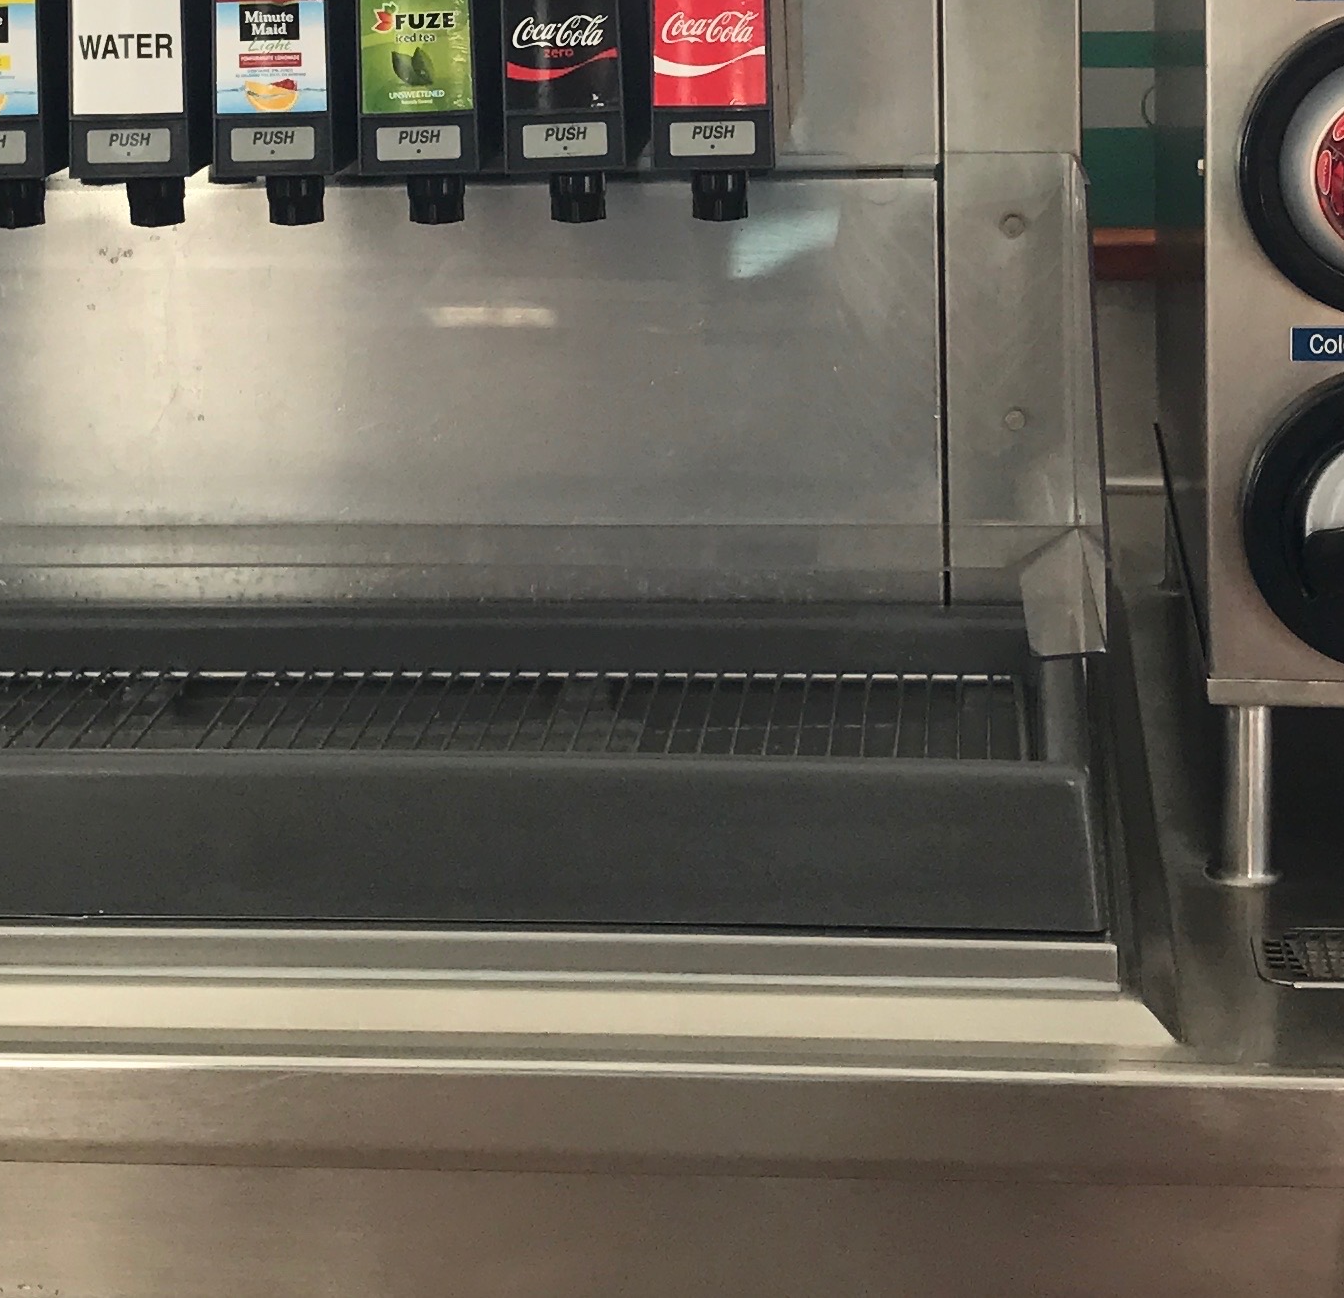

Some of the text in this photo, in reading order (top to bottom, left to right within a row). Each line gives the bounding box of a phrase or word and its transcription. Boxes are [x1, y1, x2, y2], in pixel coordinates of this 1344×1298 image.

[244, 10, 294, 23] Minute
[395, 12, 455, 30] FUZE
[251, 23, 287, 35] Maid
[512, 14, 608, 49] Coca-Cola
[661, 11, 759, 44] Coca-Cola
[396, 32, 436, 42] iced tea
[79, 33, 173, 60] WATER
[248, 37, 292, 55] Light
[543, 48, 574, 58] zero
[109, 132, 151, 147] PUSH
[253, 130, 295, 145] PUSH
[398, 129, 440, 144] PUSH
[545, 126, 587, 141] PUSH
[692, 125, 735, 140] PUSH
